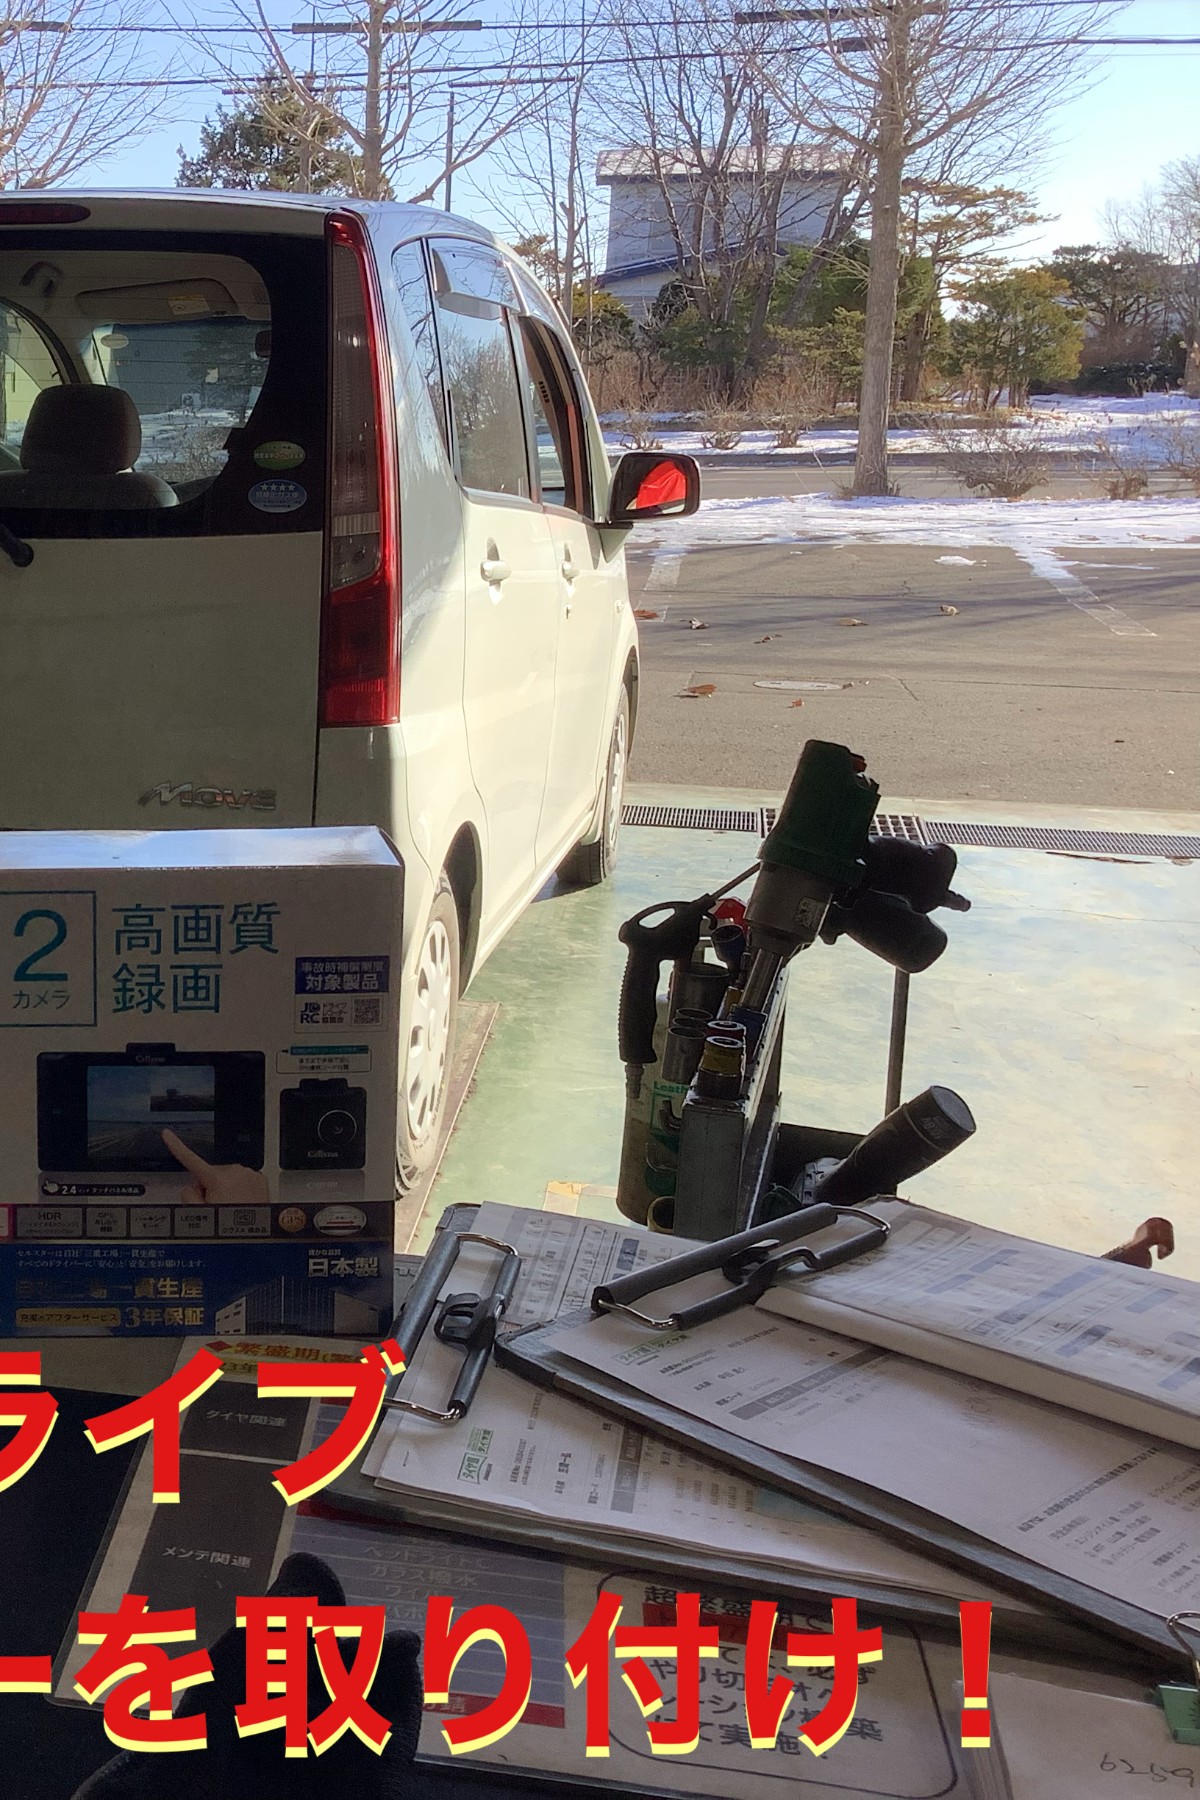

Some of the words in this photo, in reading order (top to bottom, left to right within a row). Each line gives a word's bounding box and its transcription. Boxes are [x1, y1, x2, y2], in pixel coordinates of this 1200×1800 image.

[111, 901, 282, 956] 高画質
[12, 908, 69, 982] 2
[112, 963, 223, 1015] 録画
[304, 973, 380, 992] 対象製品
[11, 989, 71, 1010] カメラ
[38, 1212, 62, 1221] HDR
[307, 1256, 380, 1278] 日本製
[125, 1307, 205, 1329] 3年保証
[205, 1409, 287, 1428] タイヤ関連
[161, 1545, 252, 1569] メンテ関連
